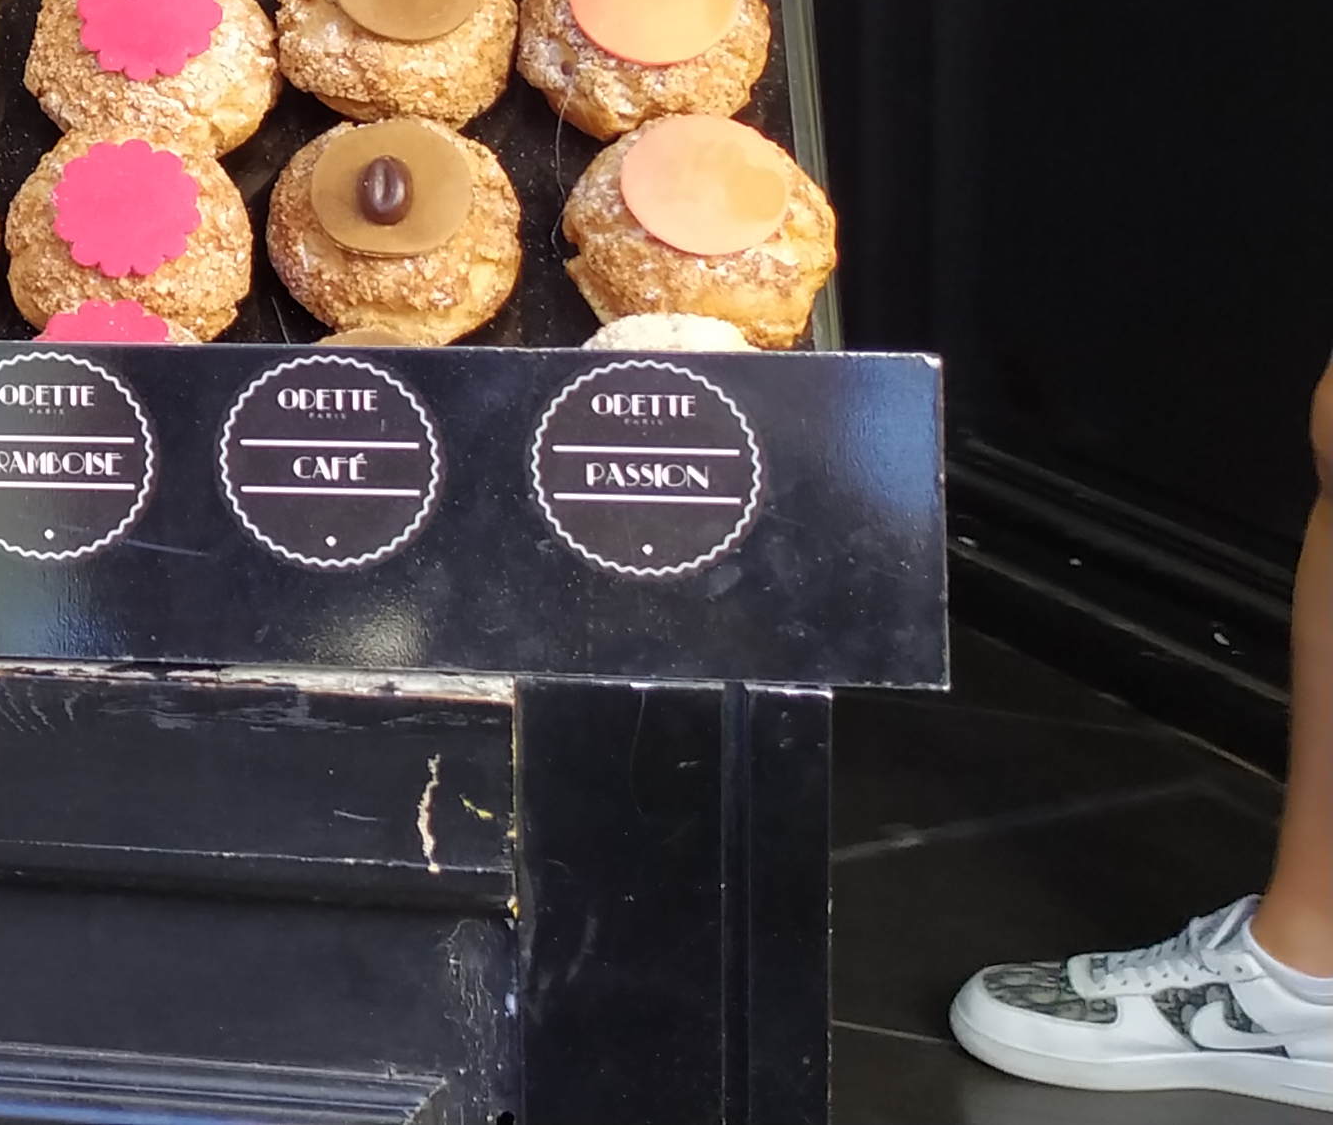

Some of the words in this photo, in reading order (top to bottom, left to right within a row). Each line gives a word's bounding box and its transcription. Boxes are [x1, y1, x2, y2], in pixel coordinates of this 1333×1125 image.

[277, 388, 378, 411] ODETTE
[591, 394, 696, 417] ODETTE
[293, 453, 367, 481] CAFÉ
[586, 462, 709, 489] PASSION
